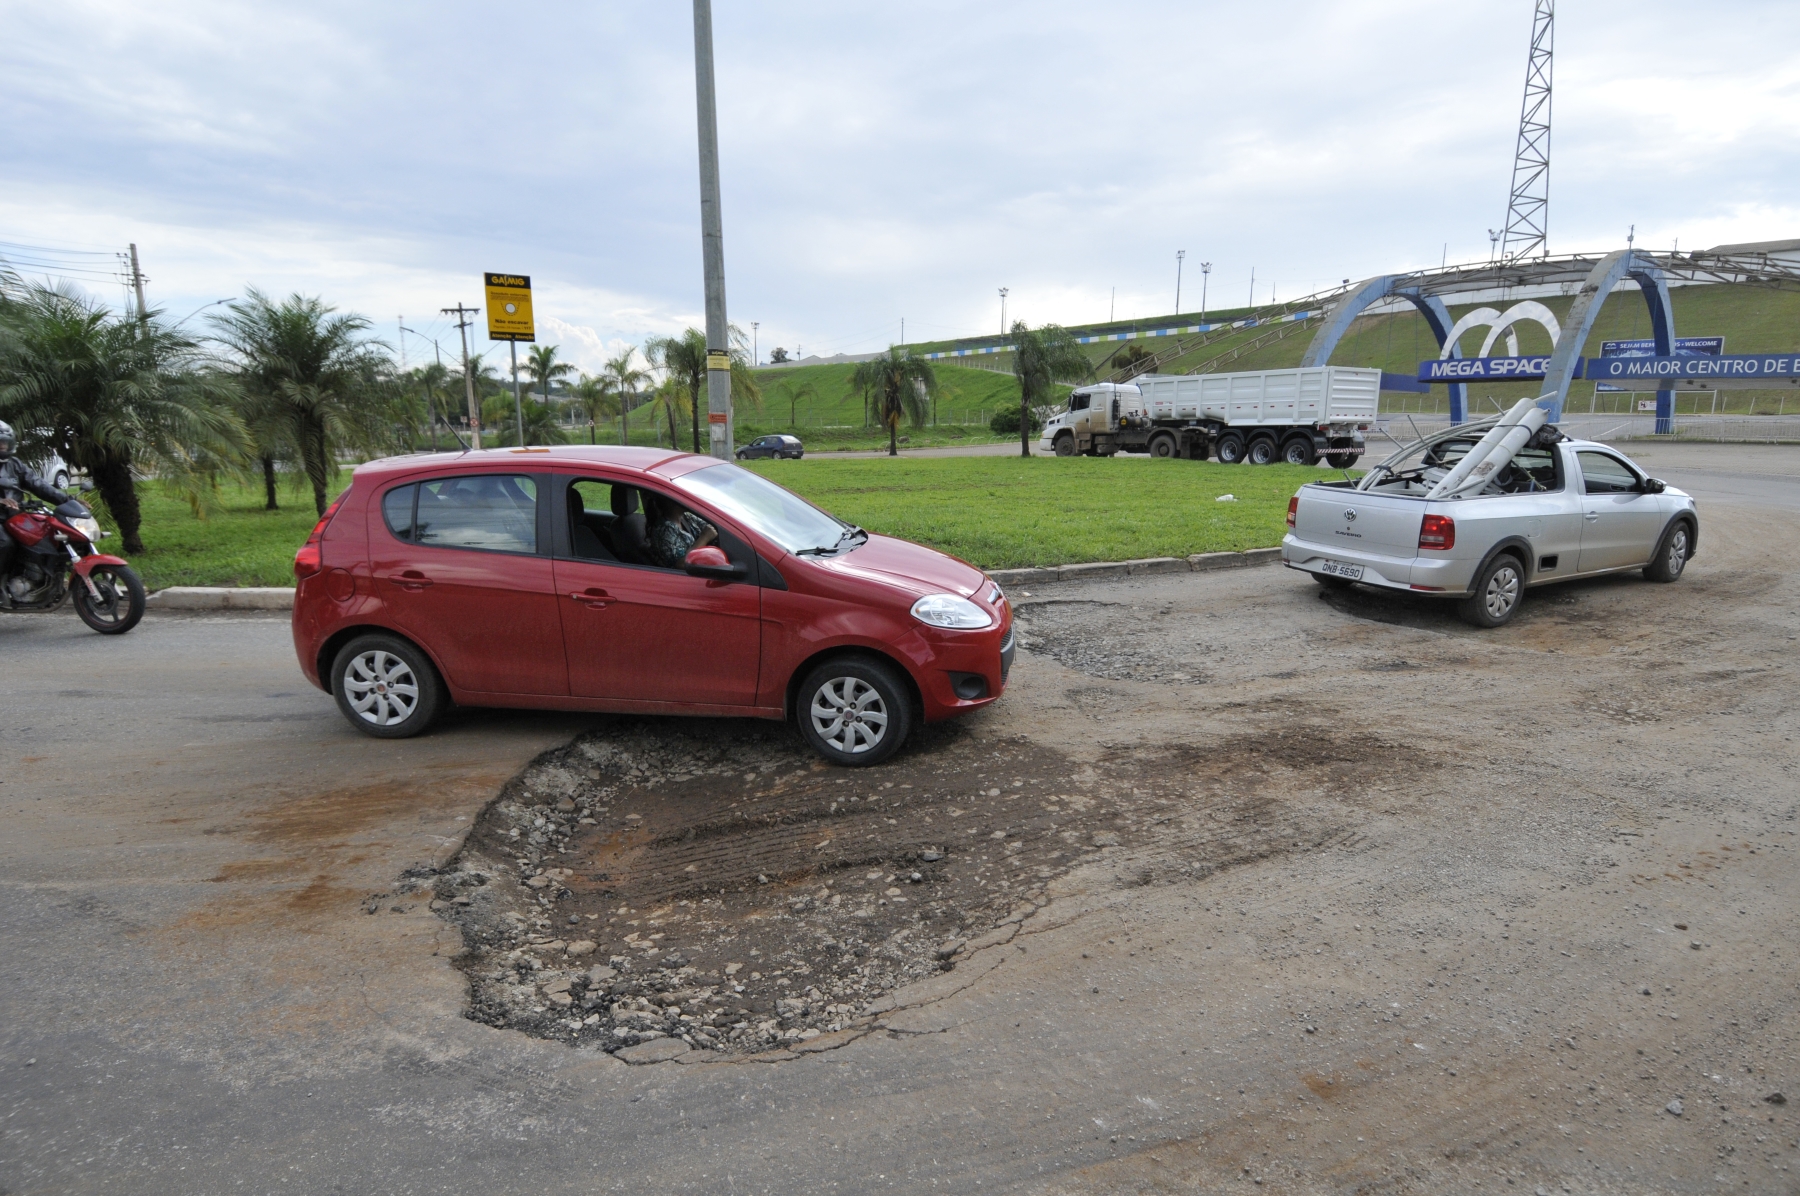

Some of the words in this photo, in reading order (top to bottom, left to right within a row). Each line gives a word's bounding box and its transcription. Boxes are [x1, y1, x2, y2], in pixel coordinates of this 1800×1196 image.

[1431, 361, 1484, 376] MEGA
[1490, 358, 1552, 374] SPACE
[1610, 362, 1622, 374] O
[1626, 361, 1681, 375] MAIOR
[1686, 360, 1758, 374] CENTRO
[1764, 359, 1789, 373] DE
